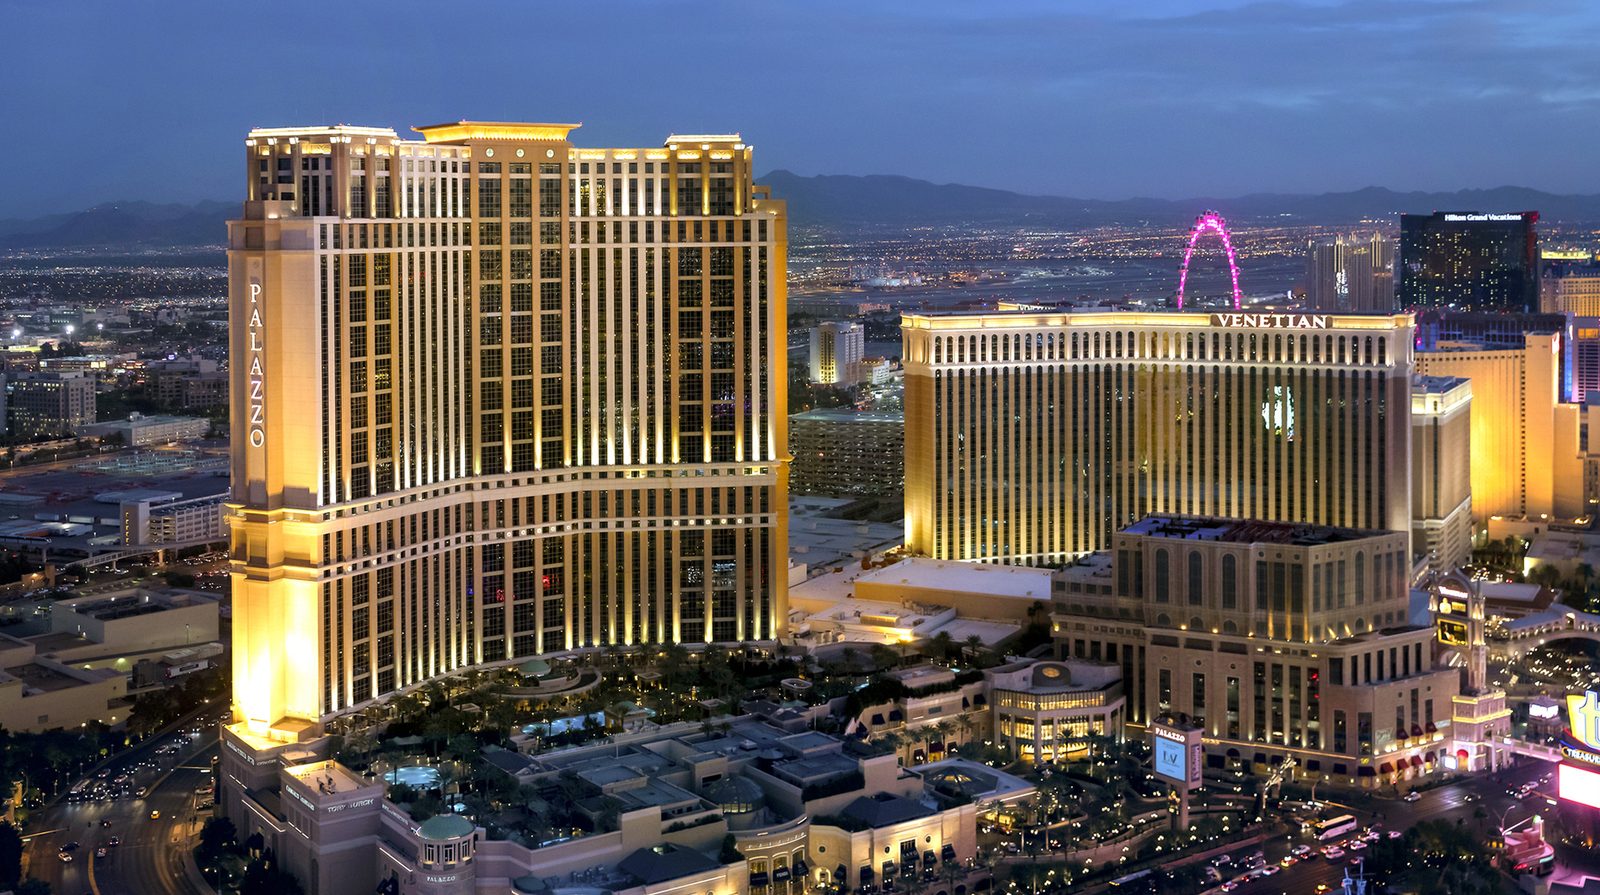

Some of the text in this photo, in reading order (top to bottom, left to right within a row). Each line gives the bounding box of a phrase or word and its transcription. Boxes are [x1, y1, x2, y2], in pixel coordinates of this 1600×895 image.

[1489, 213, 1521, 221] Vacations
[1216, 313, 1328, 329] VENETIAN
[249, 283, 265, 448] PALAZZO
[1155, 728, 1185, 742] PALAZZO
